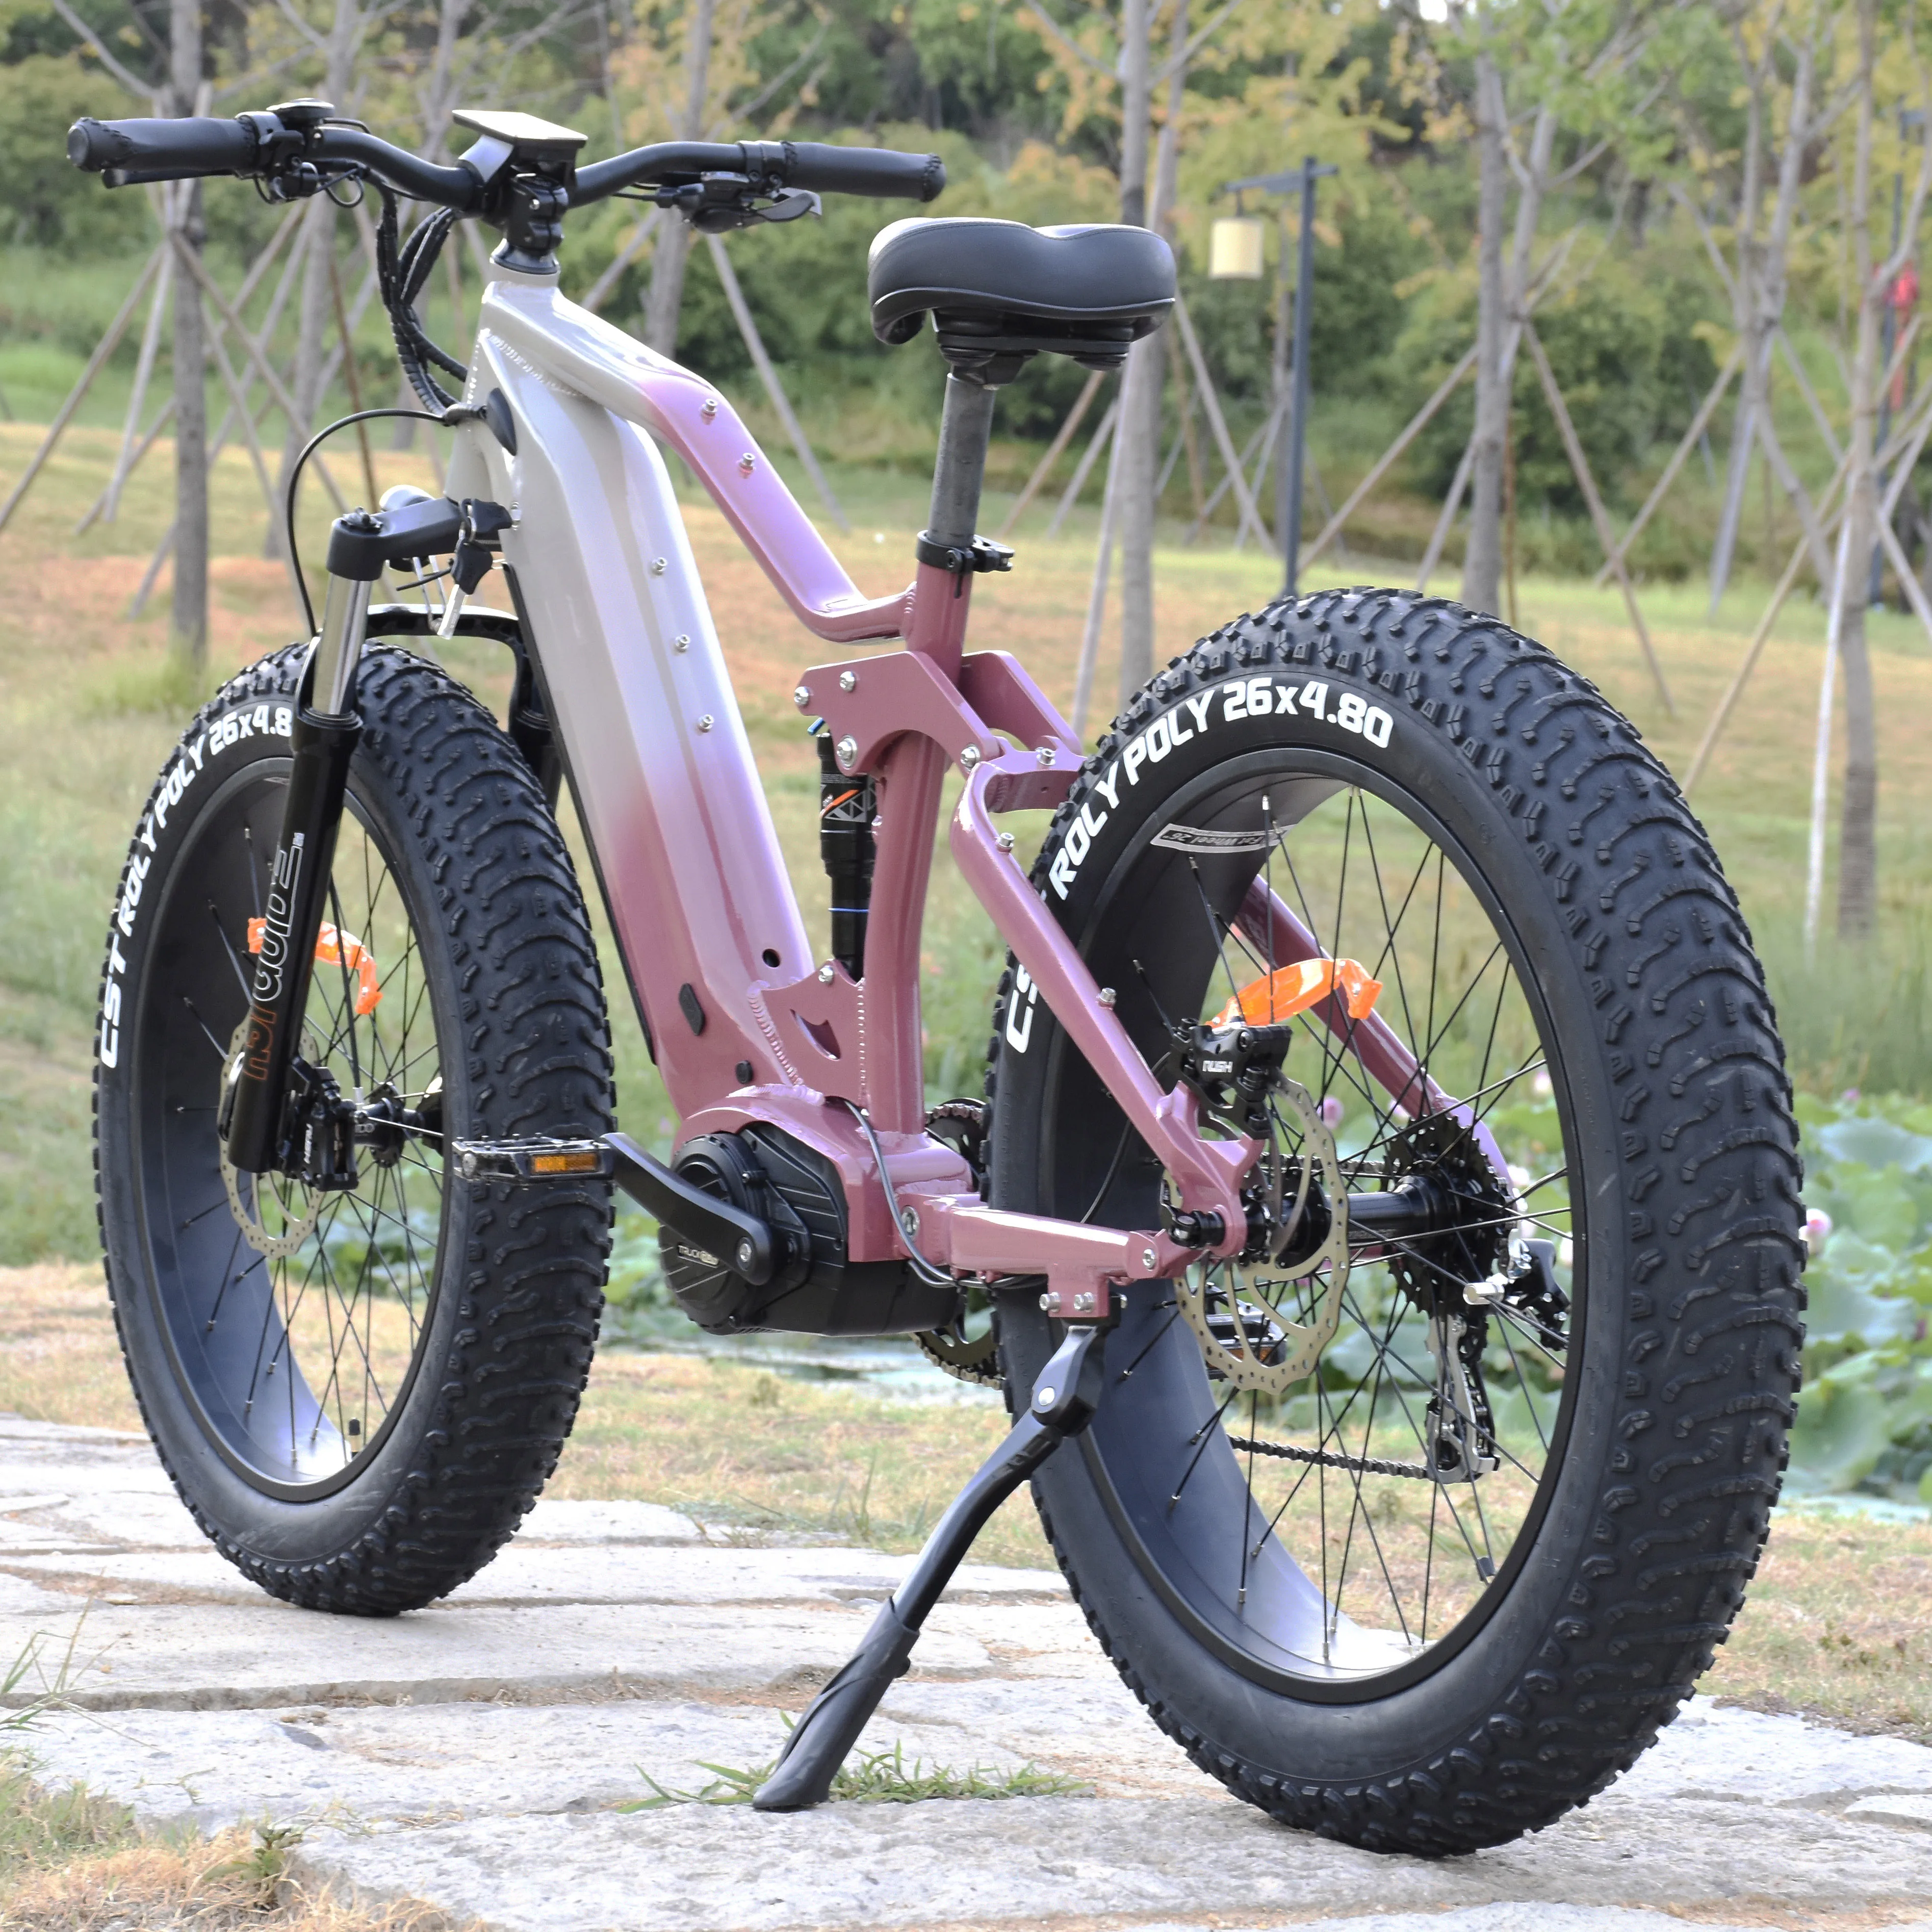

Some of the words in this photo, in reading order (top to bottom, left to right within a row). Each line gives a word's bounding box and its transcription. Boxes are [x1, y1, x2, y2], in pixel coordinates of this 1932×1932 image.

[100, 933, 126, 1069] CST
[116, 827, 157, 937] ROLY
[153, 734, 205, 829] POLY
[209, 704, 294, 756] 26x4.8
[1048, 761, 1120, 900] ROLY
[1122, 689, 1217, 786] POLY
[1223, 677, 1394, 749] 26x4.80
